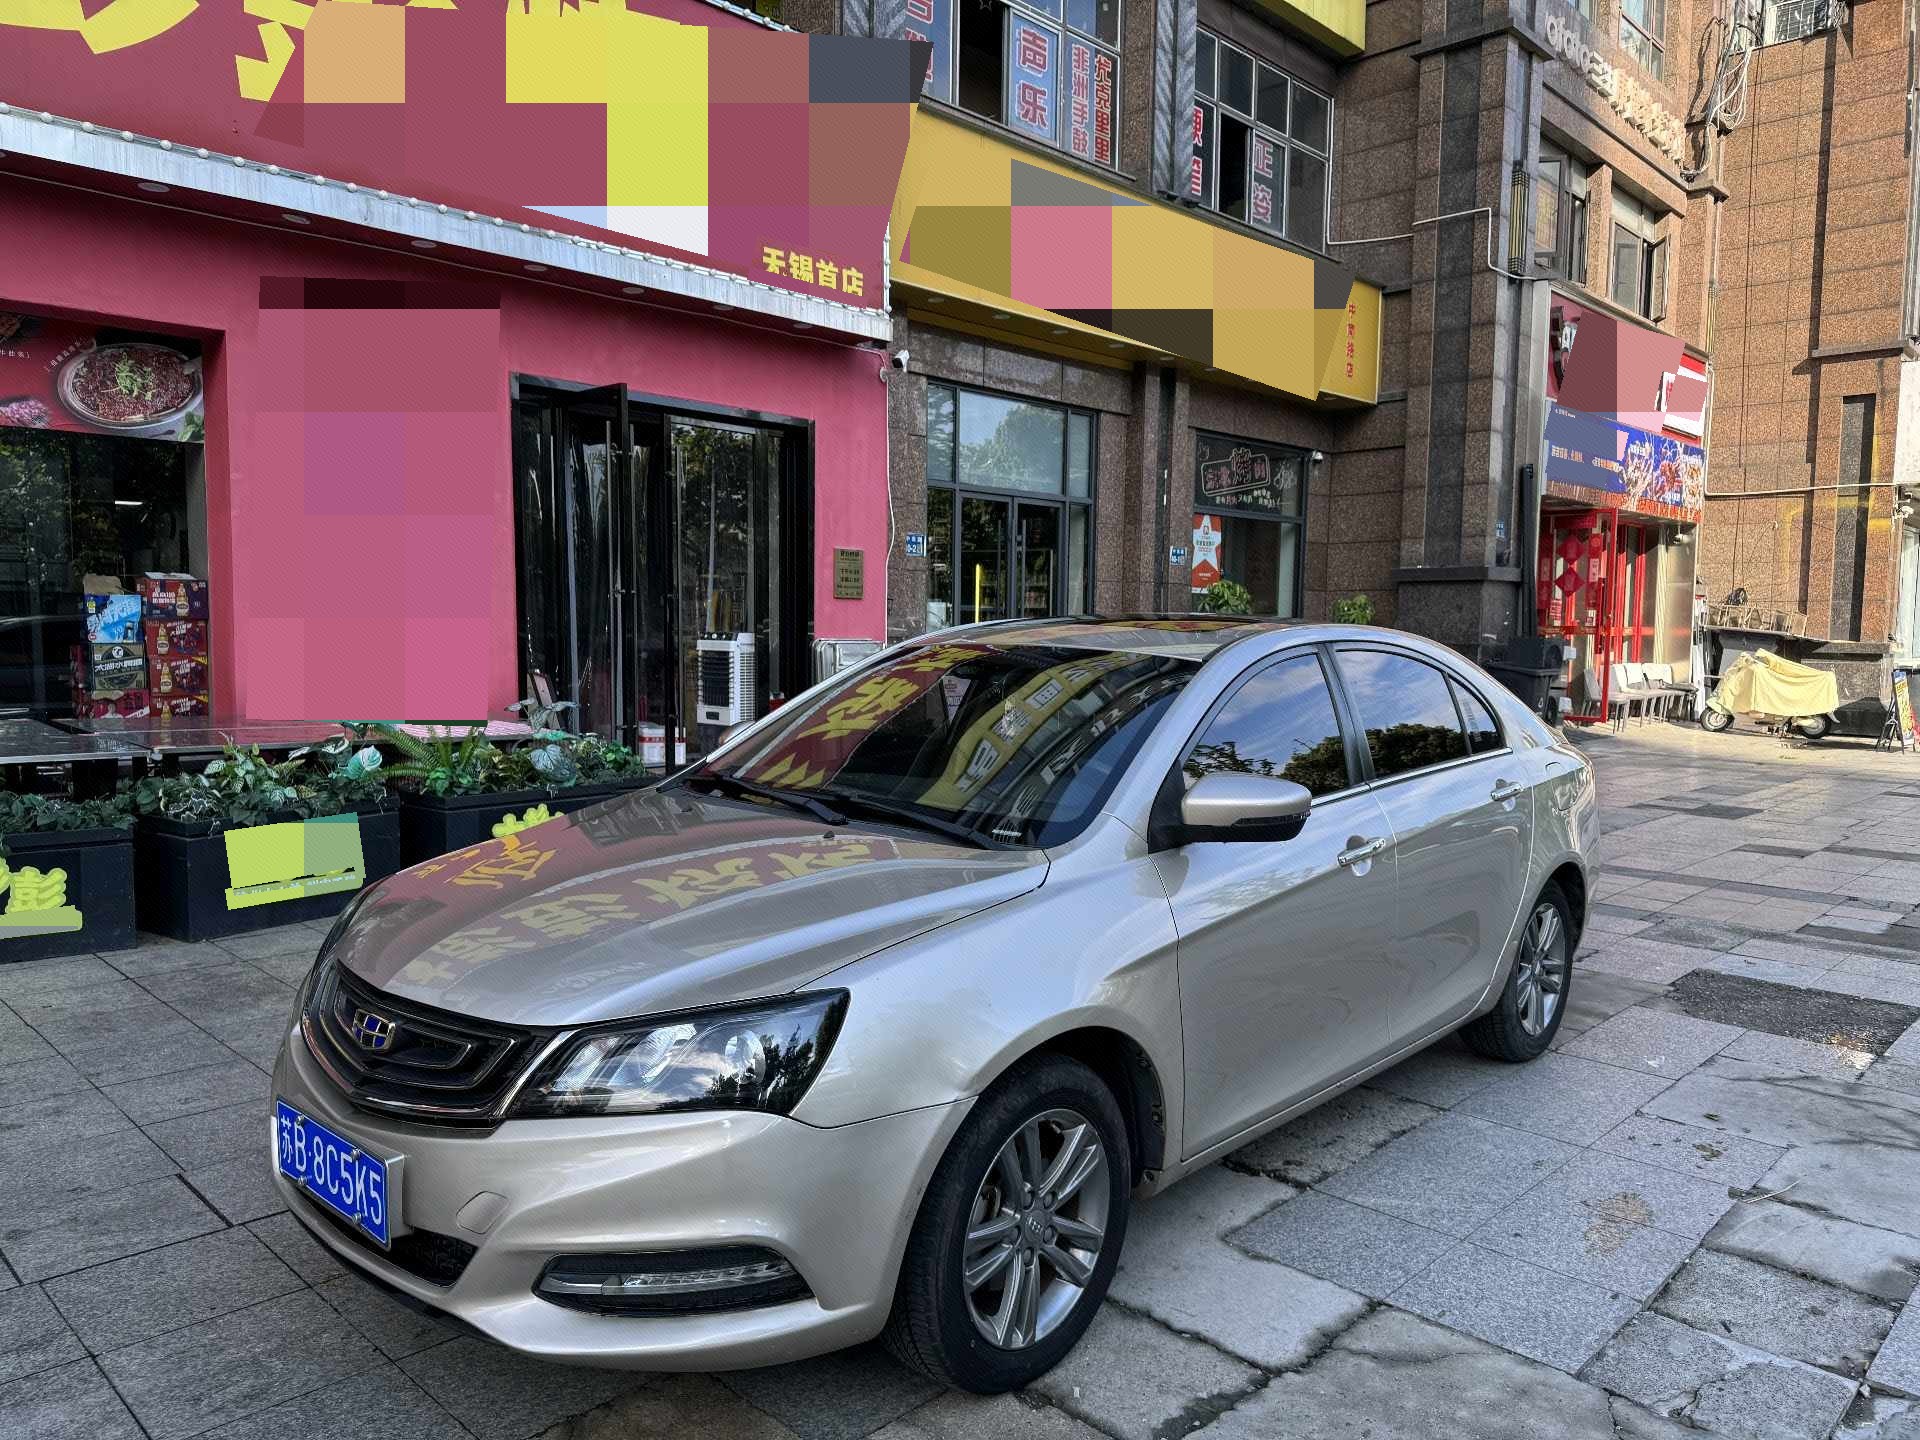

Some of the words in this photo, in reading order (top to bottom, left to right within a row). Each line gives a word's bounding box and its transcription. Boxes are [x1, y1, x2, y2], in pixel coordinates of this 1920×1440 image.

[1017, 26, 1049, 129] 声乐
[1072, 43, 1090, 156] 非洲手鼓
[1252, 136, 1273, 223] 正姿
[0, 853, 67, 915] 彭
